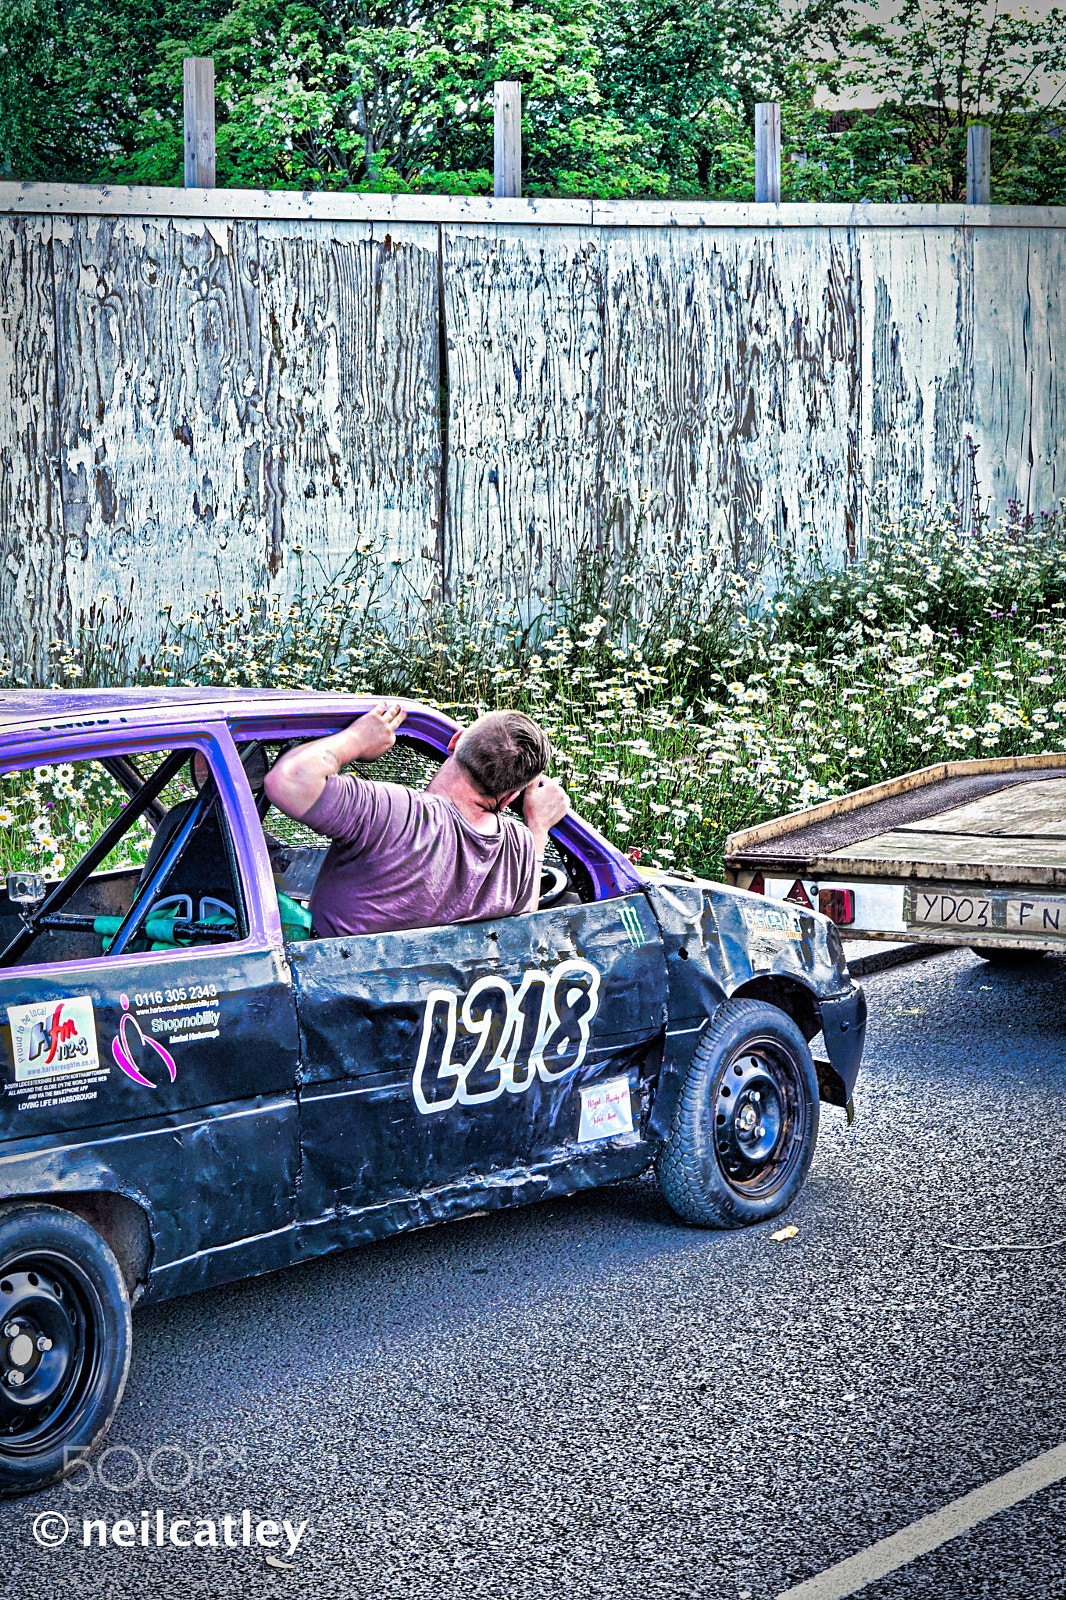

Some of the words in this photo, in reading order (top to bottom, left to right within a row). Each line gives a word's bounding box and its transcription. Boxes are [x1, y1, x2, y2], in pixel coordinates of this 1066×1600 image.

[135, 990, 163, 1007] 0116
[164, 987, 187, 1003] 305
[188, 984, 217, 1000] 2343
[151, 1010, 220, 1032] Shopmobility
[412, 959, 601, 1114] L218
[18, 1101, 39, 1111] LOVING
[40, 1099, 52, 1108] LIFE
[52, 1097, 58, 1105] IN
